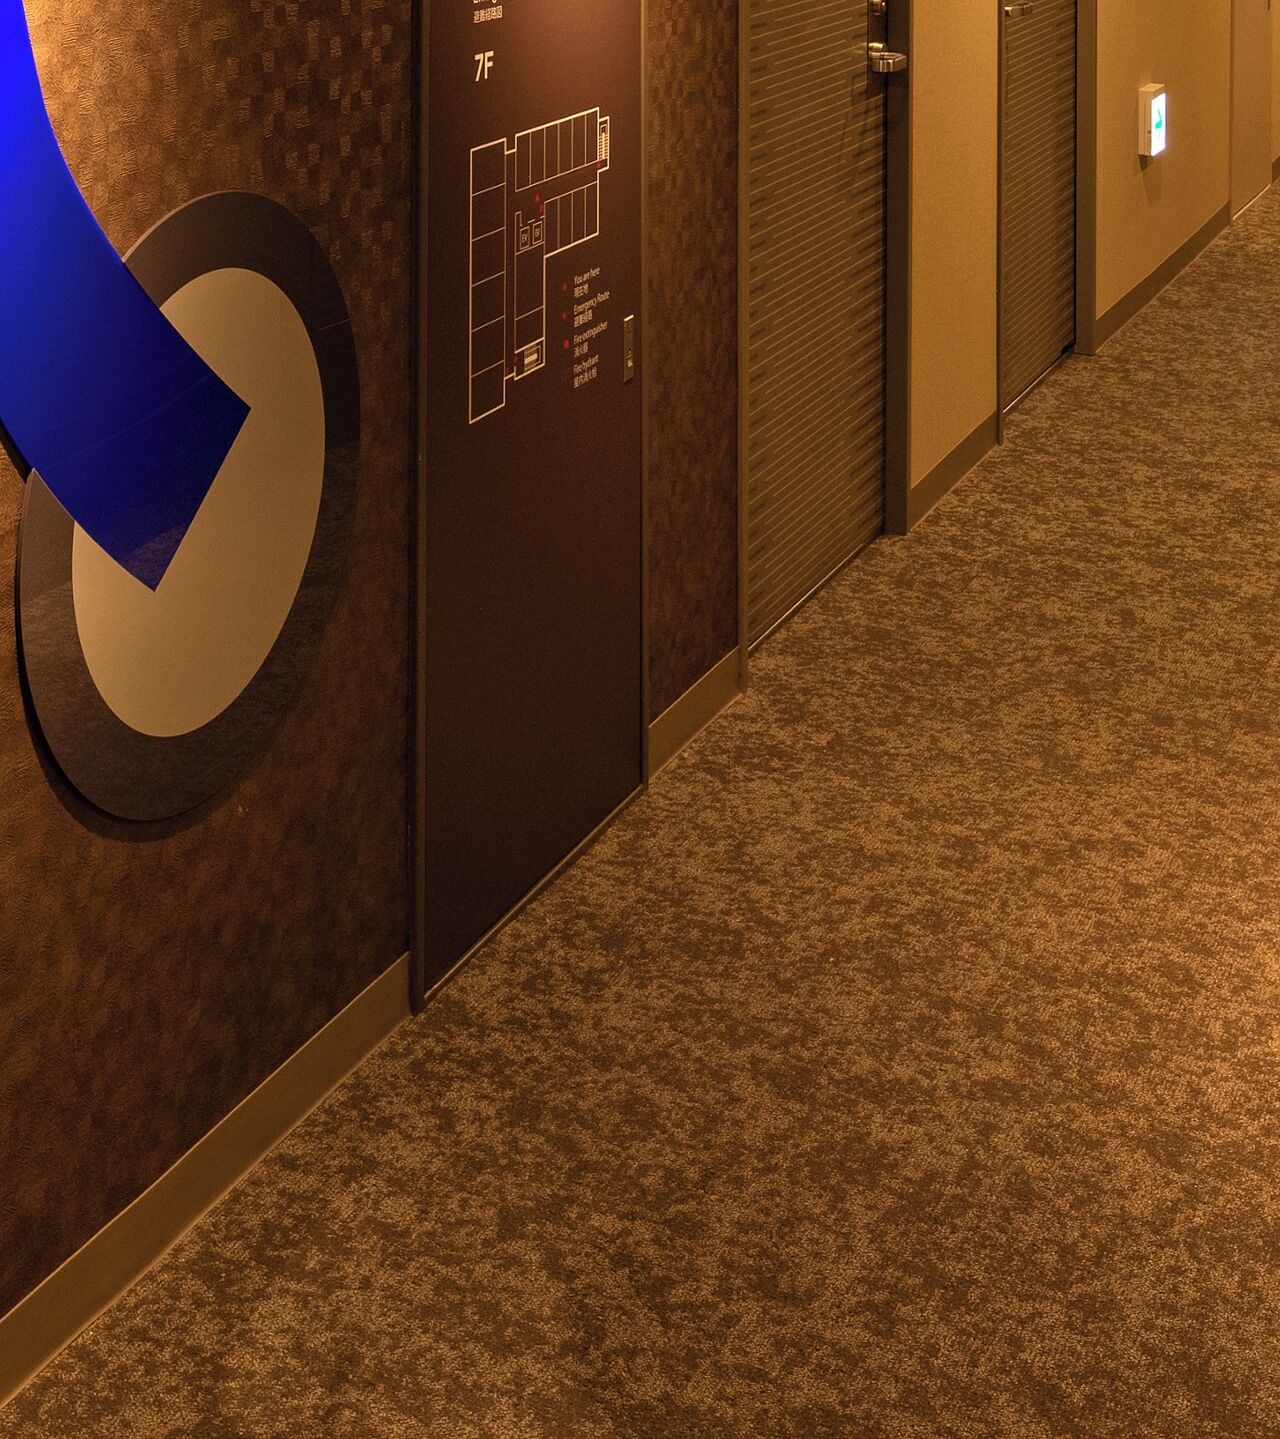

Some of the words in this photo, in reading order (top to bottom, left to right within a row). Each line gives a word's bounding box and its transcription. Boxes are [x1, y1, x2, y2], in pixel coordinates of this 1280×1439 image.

[474, 50, 495, 82] 7F
[573, 297, 597, 316] Emergency
[596, 290, 610, 303] Route
